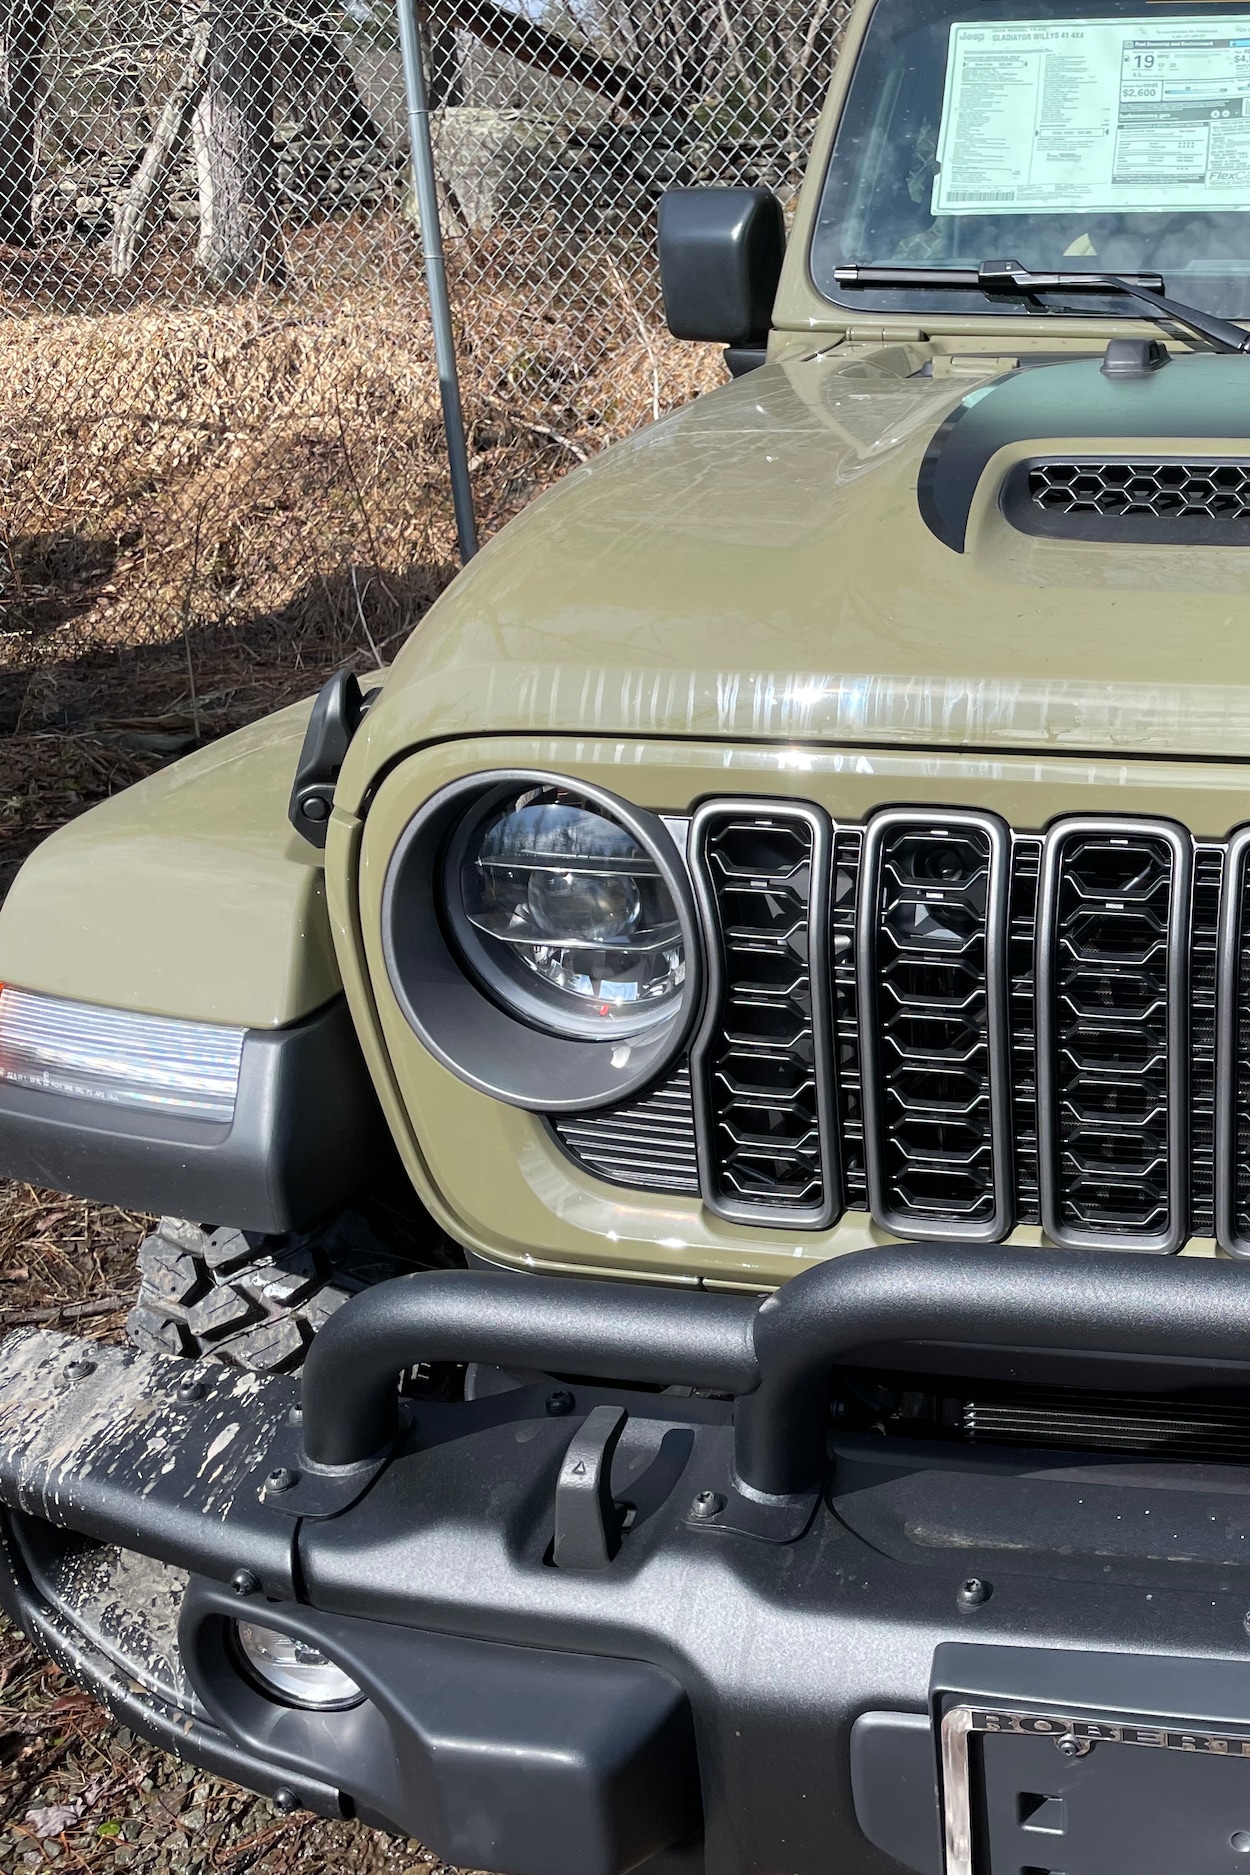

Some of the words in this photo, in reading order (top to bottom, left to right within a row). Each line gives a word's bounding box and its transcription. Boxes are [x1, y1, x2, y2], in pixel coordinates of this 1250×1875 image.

[959, 31, 985, 42] Jeep
[992, 33, 1032, 42] GLADIATOR
[1033, 32, 1060, 41] WILLYS
[1134, 54, 1155, 68] 19
[1122, 88, 1156, 97] $2,600
